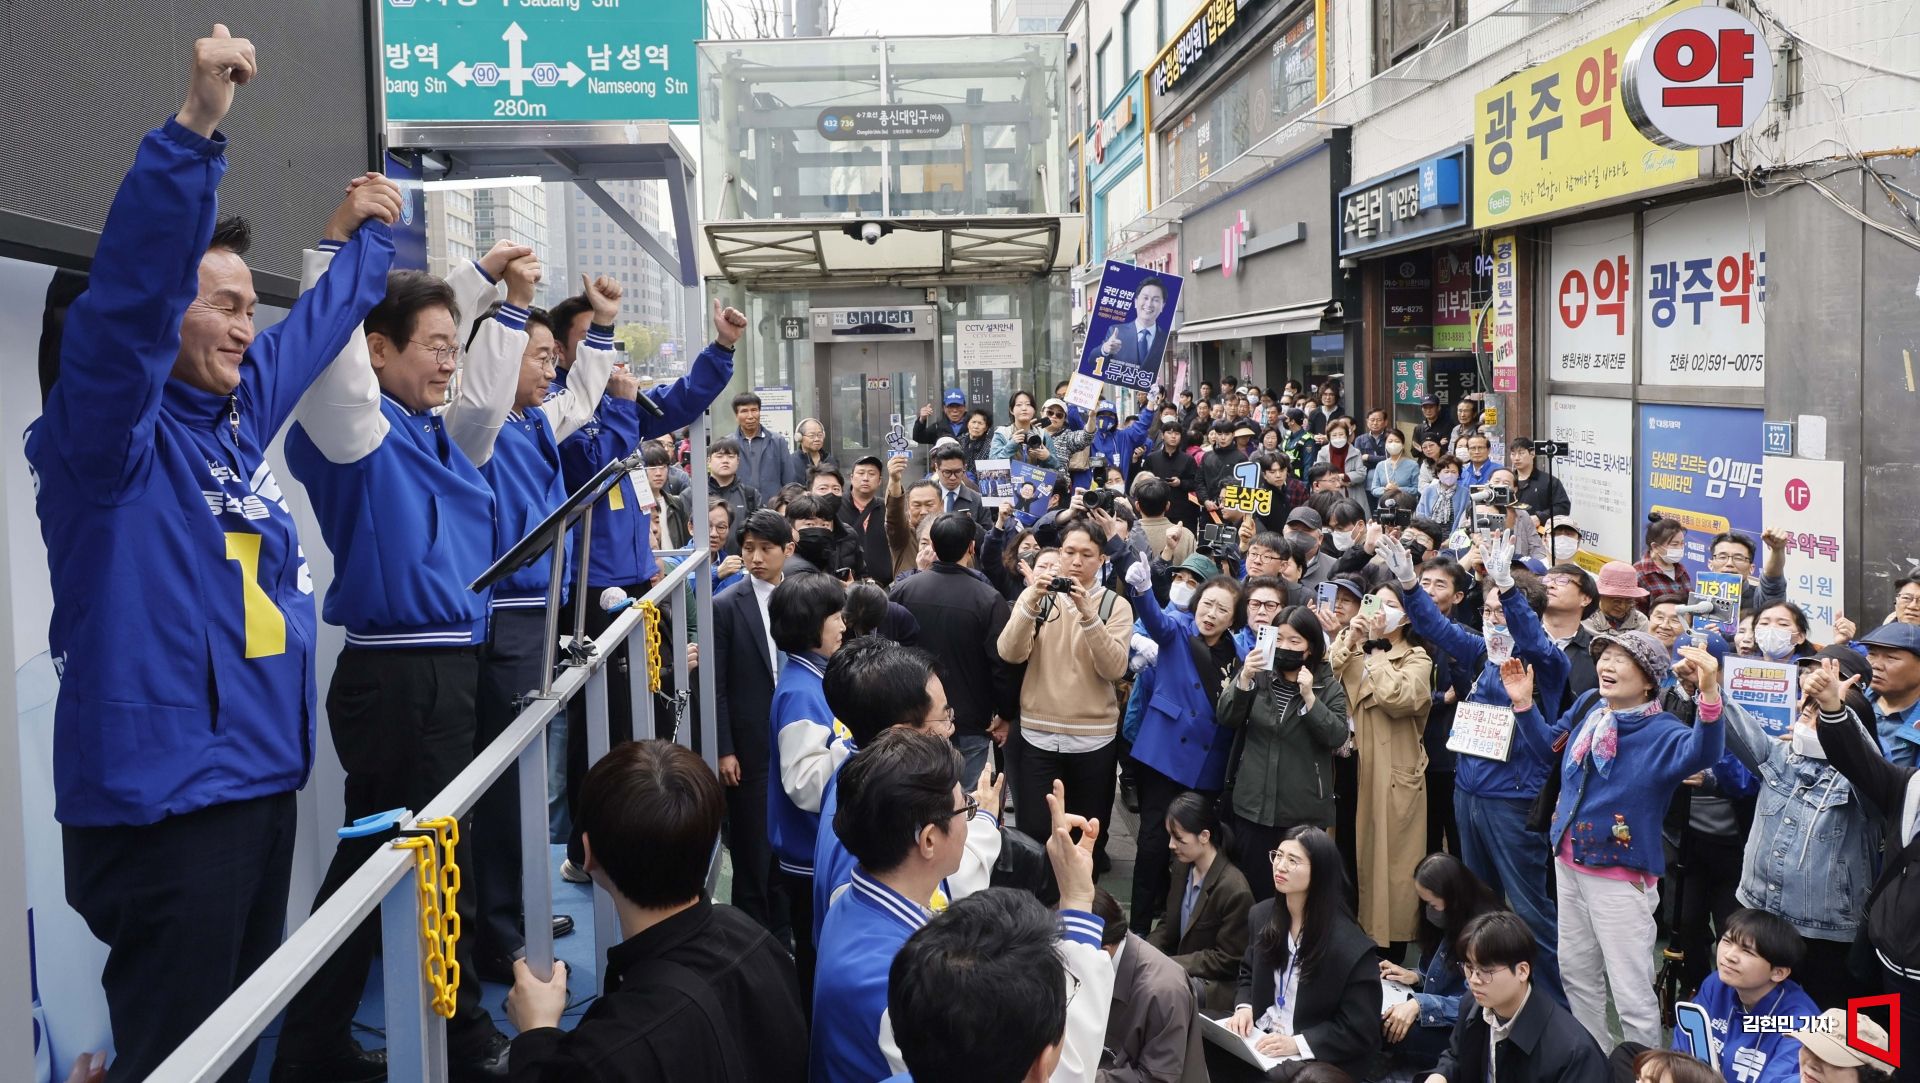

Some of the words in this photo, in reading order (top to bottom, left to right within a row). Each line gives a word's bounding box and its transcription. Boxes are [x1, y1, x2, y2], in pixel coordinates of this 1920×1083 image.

[587, 44, 669, 71] 남성역
[476, 67, 495, 83] 90
[536, 67, 555, 83] 90
[1653, 28, 1754, 128] 약
[425, 78, 447, 93] Stn
[589, 76, 655, 97] Namseong
[665, 76, 688, 94] Stn
[493, 100, 547, 116] 280m
[879, 109, 928, 126] 총신대입구
[823, 119, 838, 127] 432
[840, 119, 854, 127] 736
[1344, 186, 1383, 239] 스릴러
[1387, 183, 1420, 222] 게임장
[1488, 198, 1510, 210] feels
[1593, 255, 1630, 335] 약
[965, 324, 984, 332] CCTV
[985, 322, 1013, 333] 설치안내
[1495, 339, 1514, 362] OPEN
[1092, 356, 1104, 377] 1
[1561, 352, 1591, 369] 병원처방
[1593, 352, 1626, 370] 조제전문
[1669, 353, 1689, 372] 전화
[1690, 352, 1763, 372] 02)591-0075
[1104, 362, 1155, 388] 류삼영
[1768, 432, 1786, 446] 127
[1651, 451, 1678, 470] 당신만
[1680, 454, 1707, 474] 모르는
[1650, 471, 1693, 494] 대세비타민
[1224, 485, 1272, 513] 류삼영
[1788, 486, 1807, 505] 1F
[1732, 690, 1768, 702] 심판의
[1770, 692, 1788, 704] 날!
